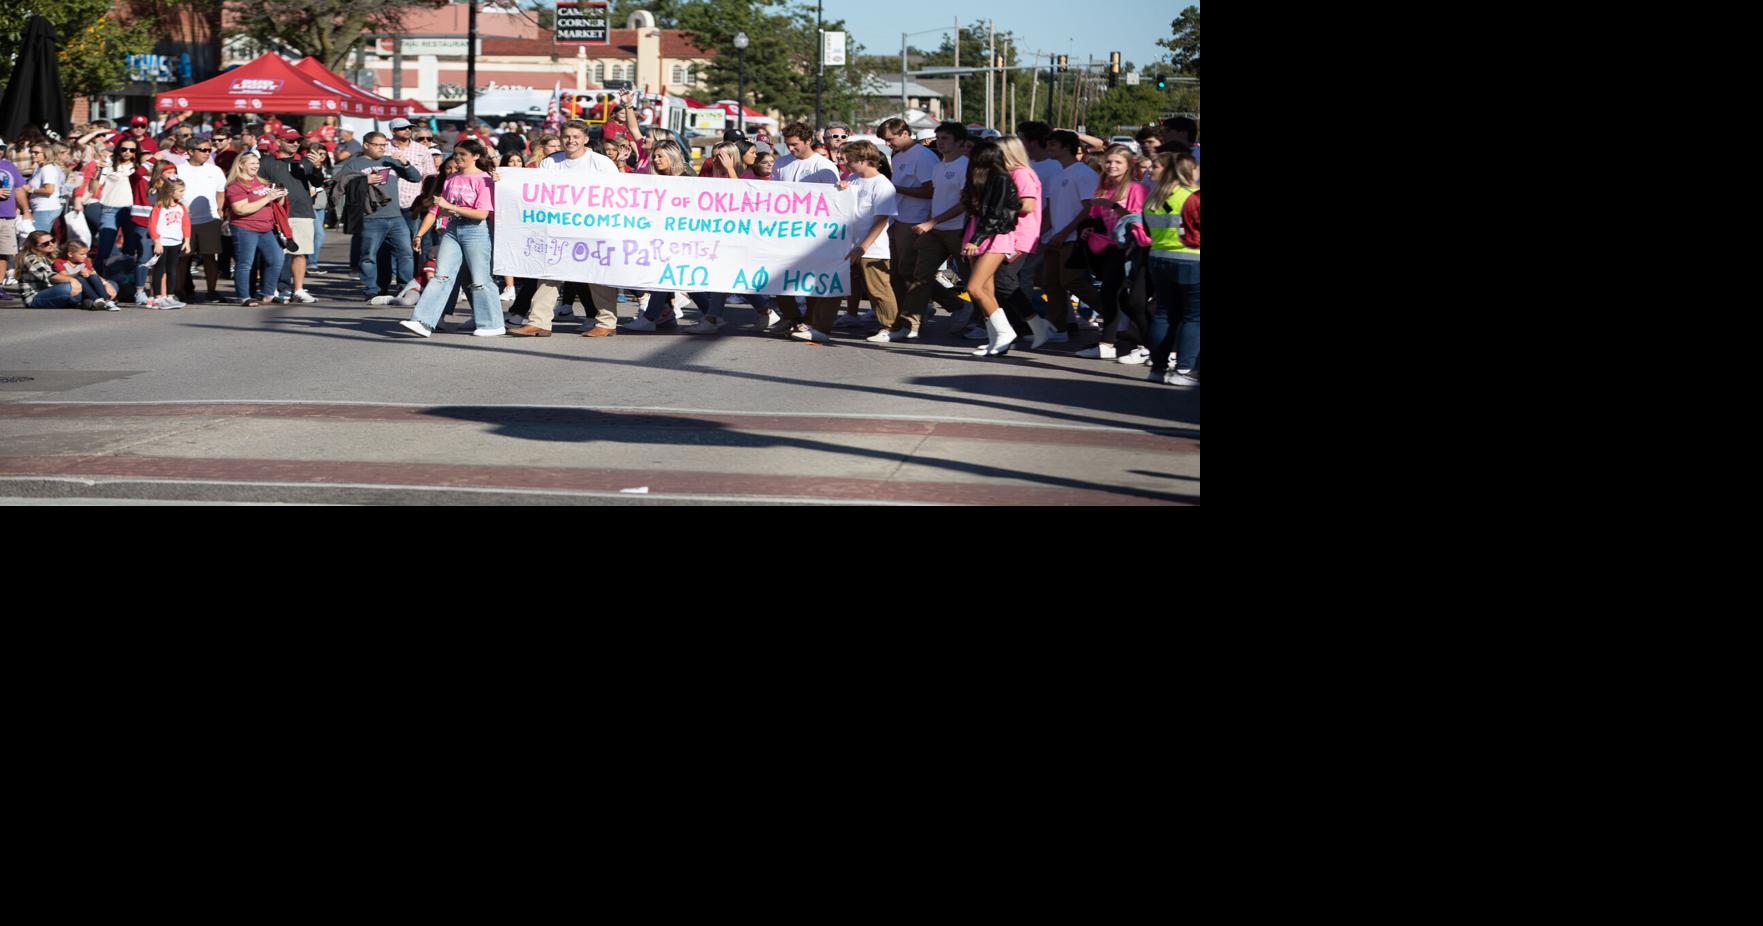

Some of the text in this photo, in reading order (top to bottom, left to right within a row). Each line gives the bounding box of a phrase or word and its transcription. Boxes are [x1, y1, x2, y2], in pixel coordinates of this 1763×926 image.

[557, 18, 606, 28] CORNER
[557, 29, 605, 38] MARKET
[522, 182, 830, 217] UNIVERSITY OF OKLAHOMA
[522, 209, 846, 240] HOMECOMING REUNION WEEK '21
[572, 239, 615, 266] Odd
[783, 269, 844, 295] HCSA
